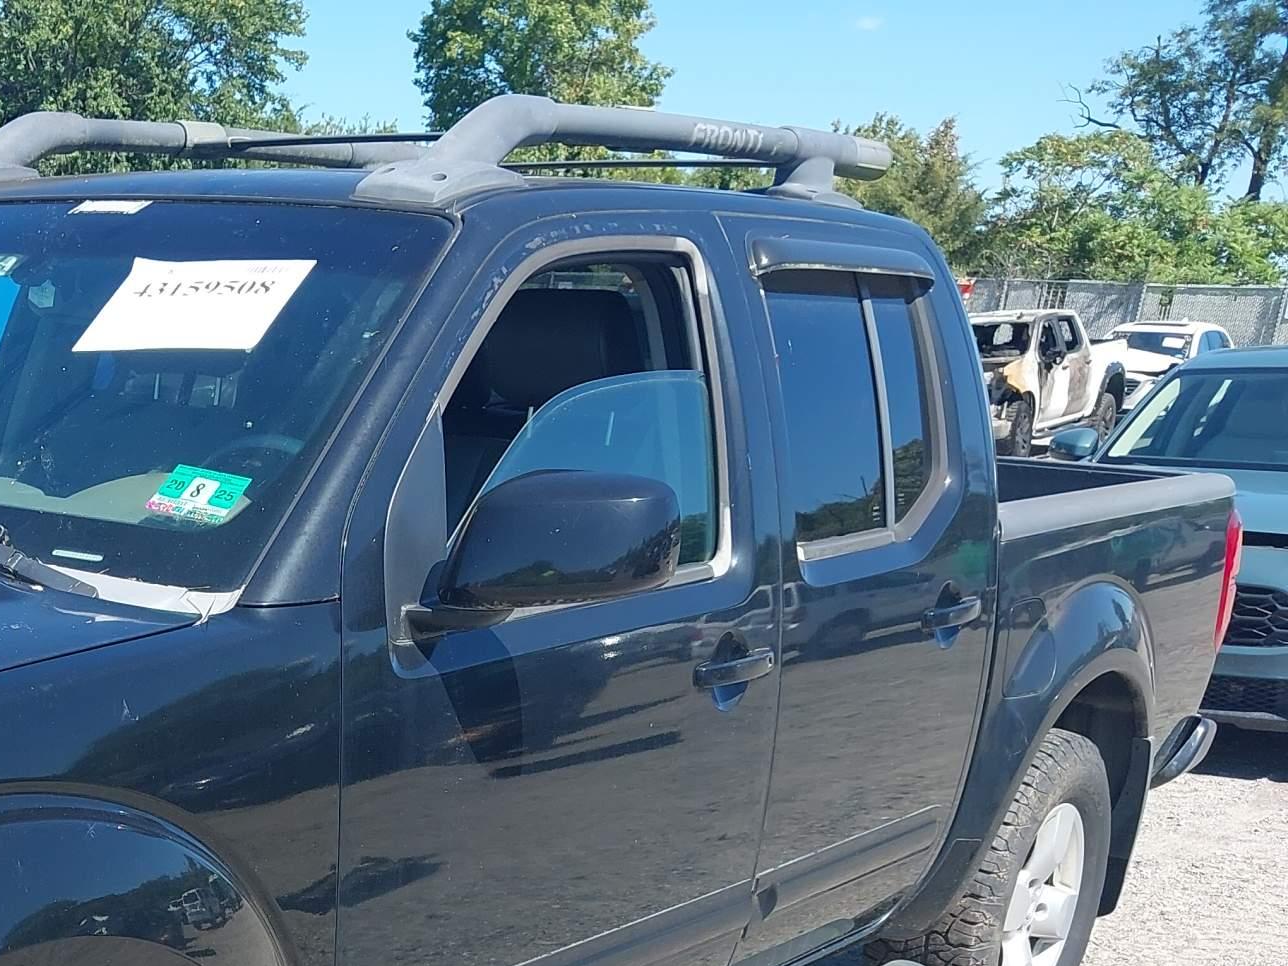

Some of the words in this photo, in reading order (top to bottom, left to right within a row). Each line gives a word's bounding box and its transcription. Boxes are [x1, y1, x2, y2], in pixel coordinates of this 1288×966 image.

[132, 280, 276, 298] 43159508
[165, 478, 186, 492] 20
[189, 482, 206, 498] 8
[214, 488, 234, 502] 25
